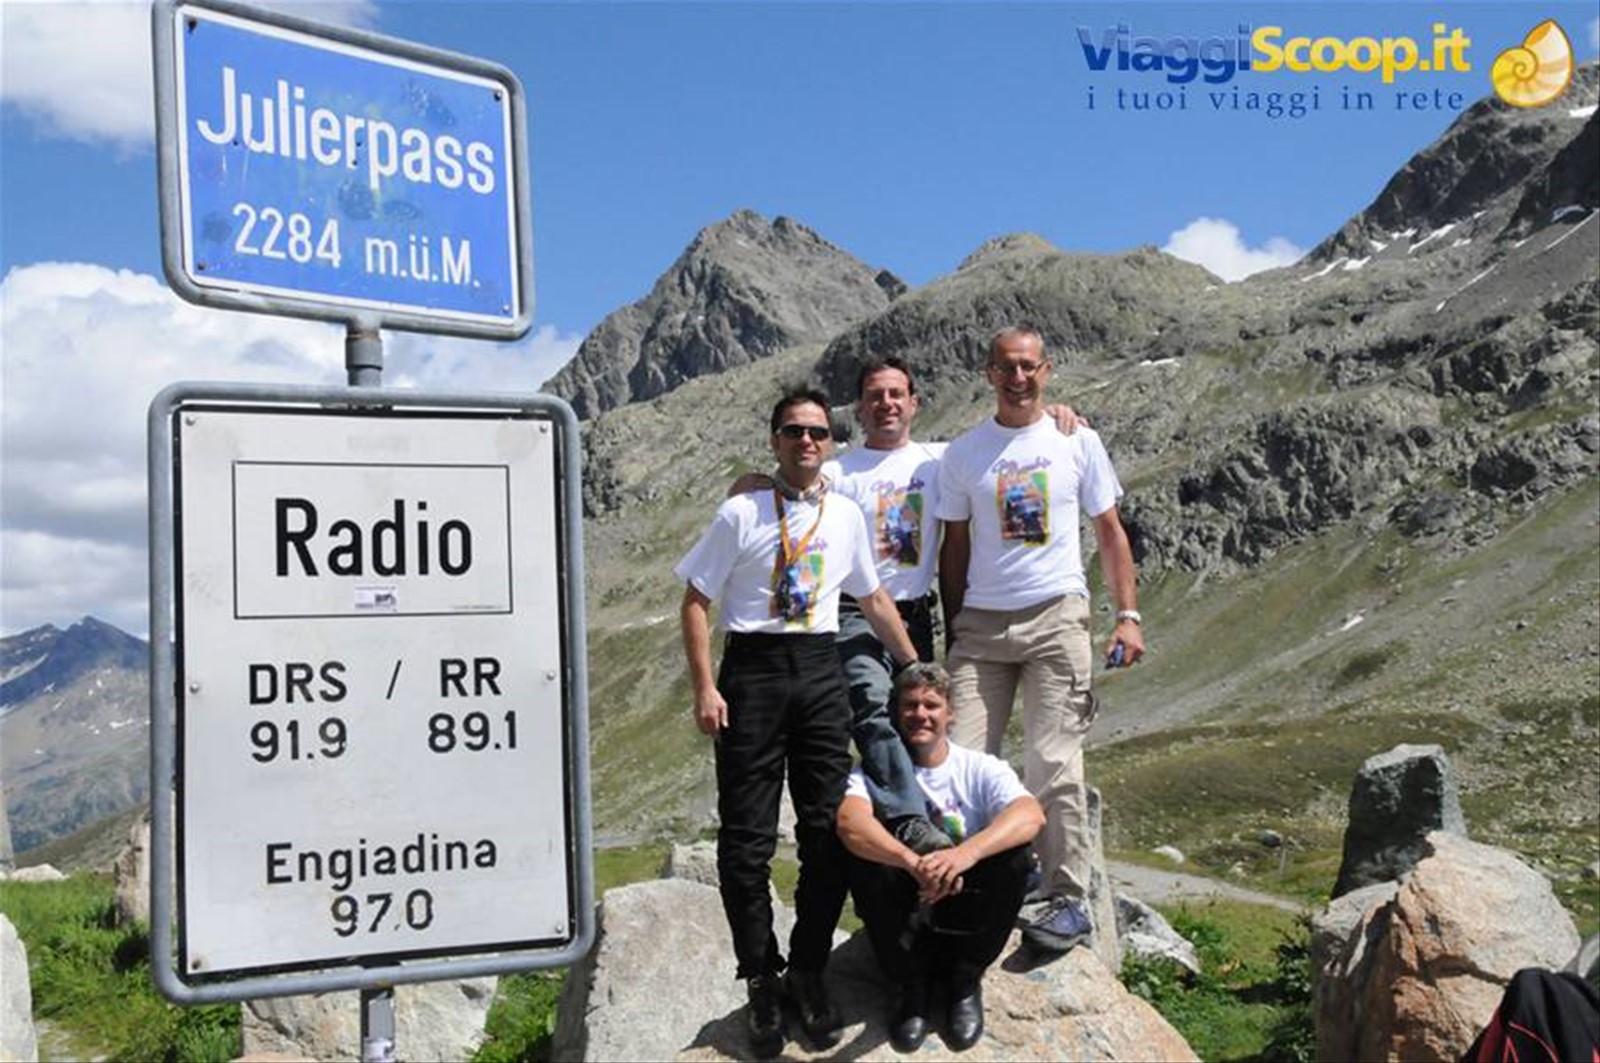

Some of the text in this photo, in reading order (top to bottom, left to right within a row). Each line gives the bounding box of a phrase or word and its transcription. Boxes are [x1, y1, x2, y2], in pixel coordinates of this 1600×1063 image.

[197, 67, 494, 194] Julierpass
[233, 203, 480, 287] 2284 m.ü.M.
[275, 498, 472, 577] Radio
[249, 657, 501, 705] DRS / RR
[250, 710, 517, 763] 91.9 89.1
[266, 834, 497, 891] Engiadina
[330, 889, 433, 937] 97.0
